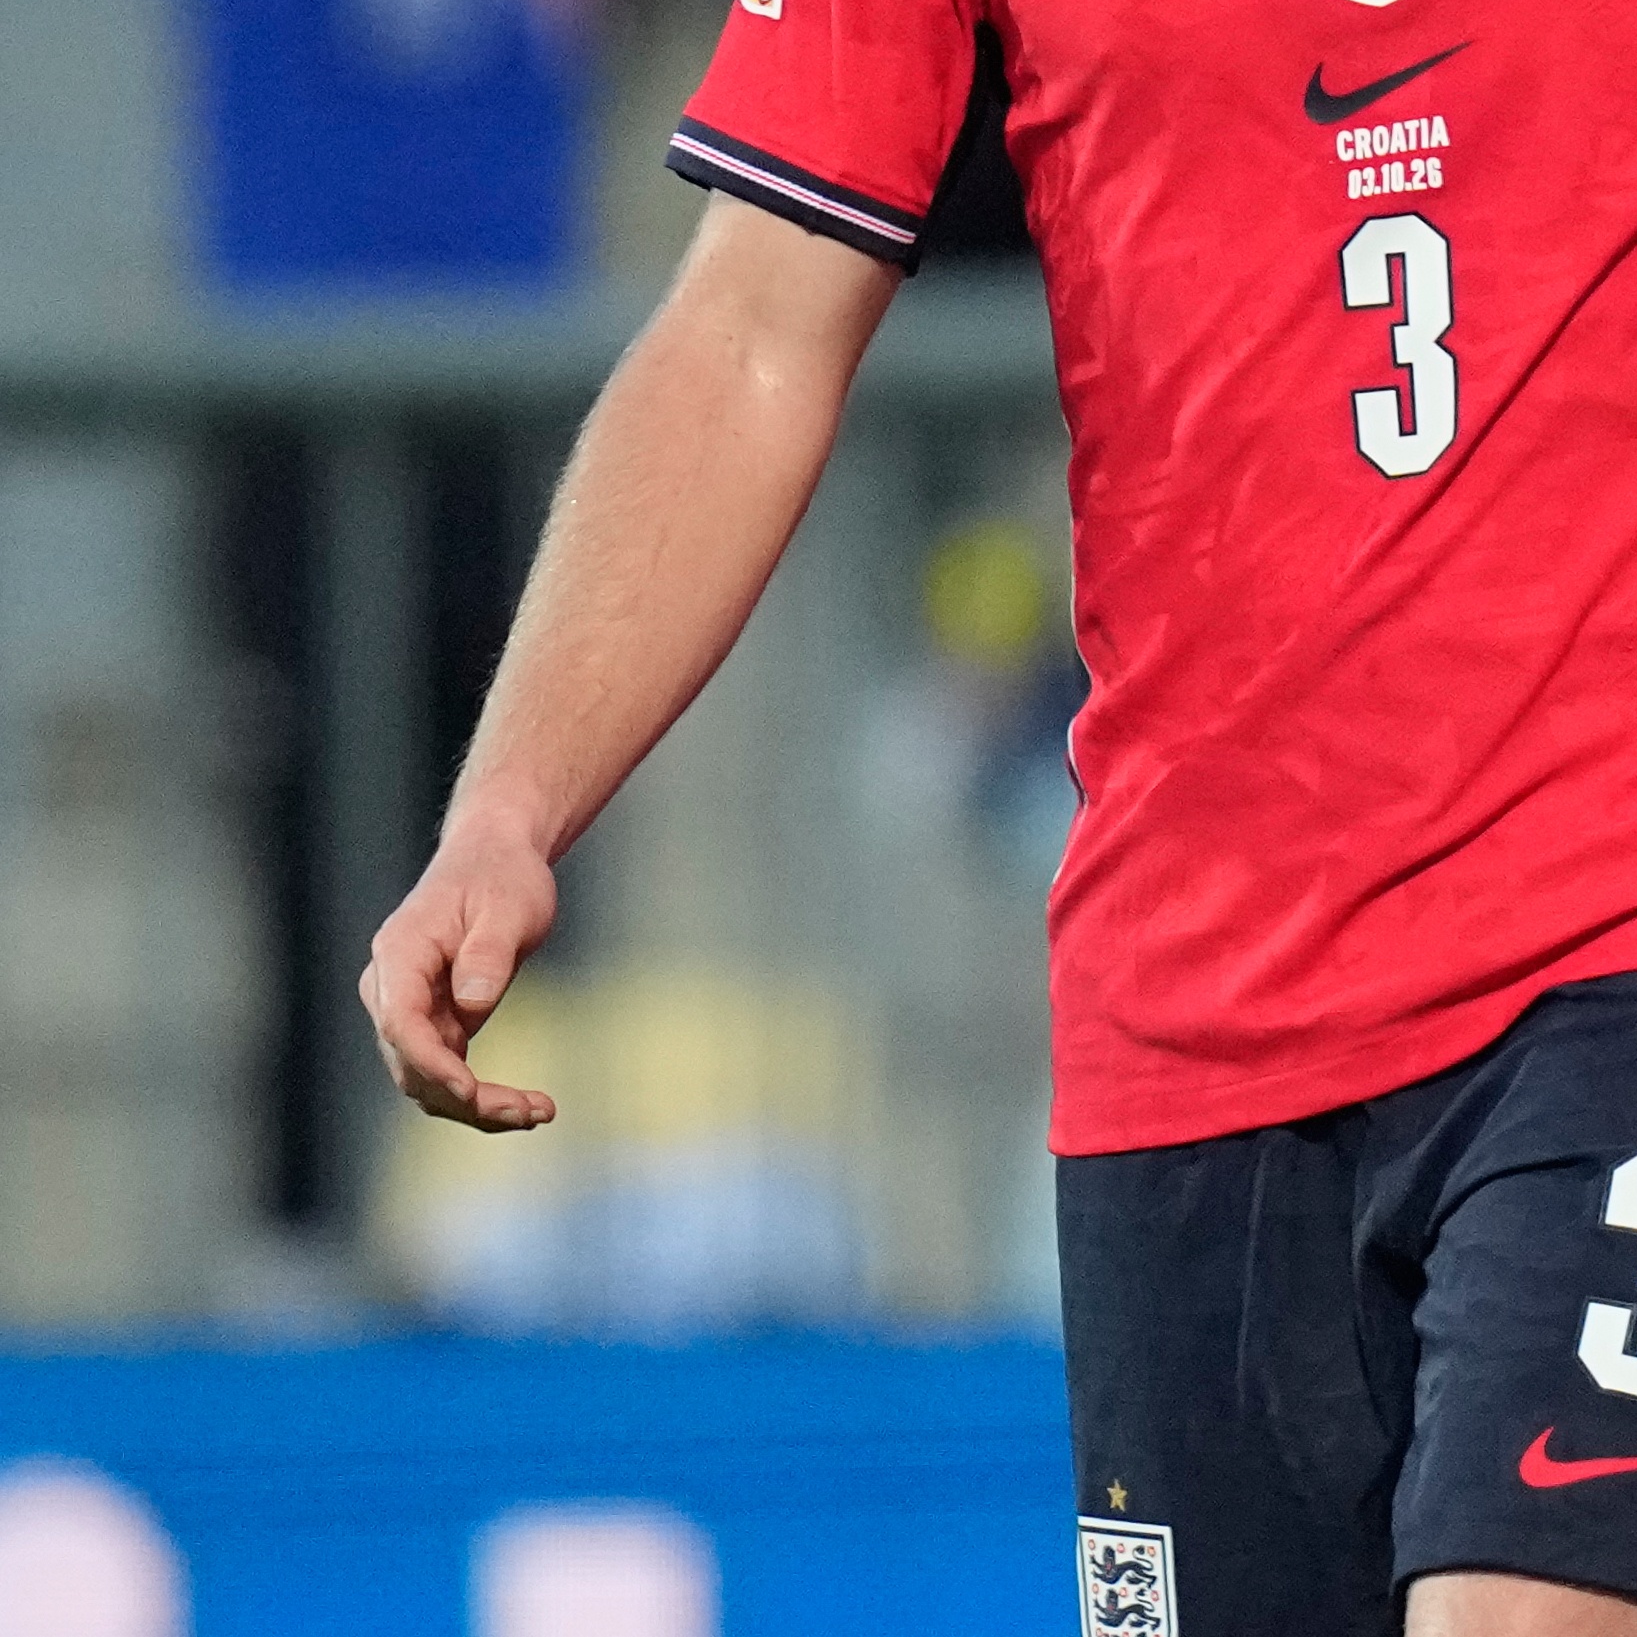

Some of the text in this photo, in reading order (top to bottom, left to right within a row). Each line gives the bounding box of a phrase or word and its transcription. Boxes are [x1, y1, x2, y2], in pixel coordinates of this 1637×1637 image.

[1336, 115, 1450, 162] CROATIA
[1347, 156, 1443, 200] 03.10.26
[1339, 212, 1458, 479] 3
